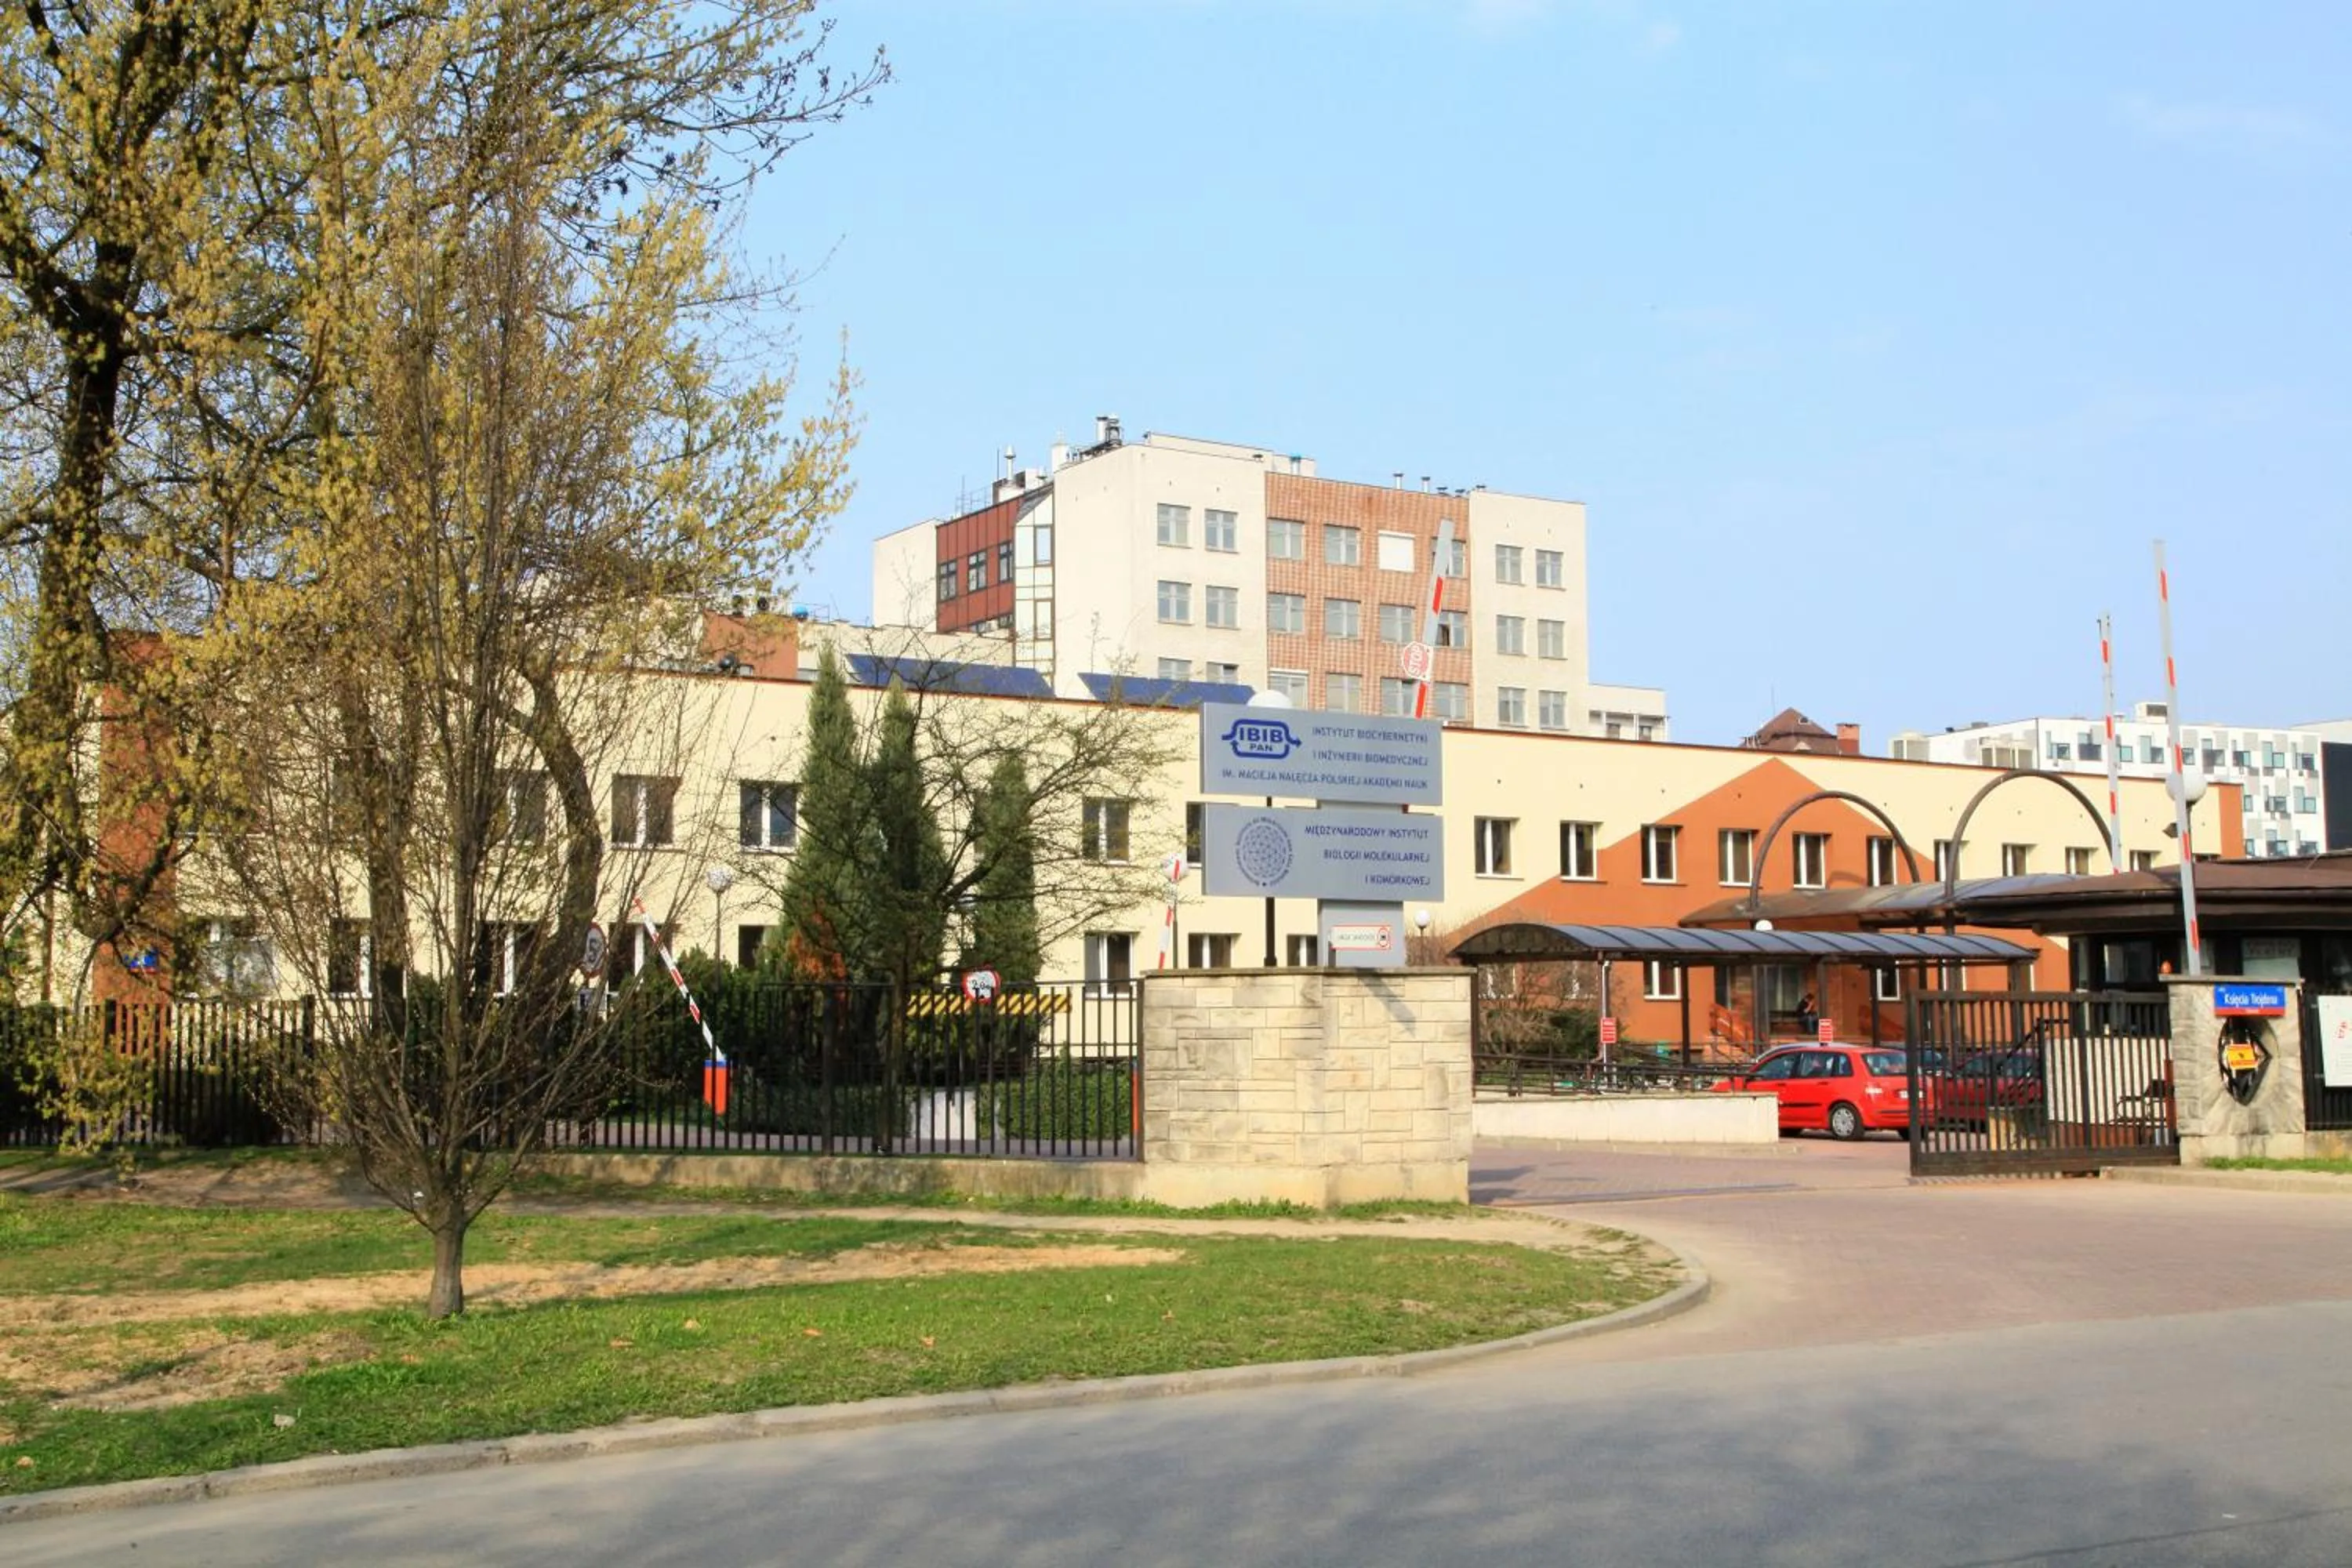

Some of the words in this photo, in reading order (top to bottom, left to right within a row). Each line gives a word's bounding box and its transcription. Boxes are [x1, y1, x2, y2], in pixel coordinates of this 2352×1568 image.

[1407, 644, 1423, 677] STOP
[1240, 727, 1283, 743] IBIB
[1312, 726, 1356, 739] INSTYTUT
[1357, 728, 1428, 743] BIOCYBERNETYKI
[1250, 743, 1273, 752] PAN
[1365, 752, 1428, 766] BIOMEDYCZNEJ
[1239, 769, 1277, 781] MACIEJA
[1319, 773, 1361, 786] POLSKIEJ
[1388, 827, 1428, 840] INSTYTUT
[1323, 848, 1362, 861] BIOLOGII
[1363, 849, 1430, 863] MOLEKULARNEJ
